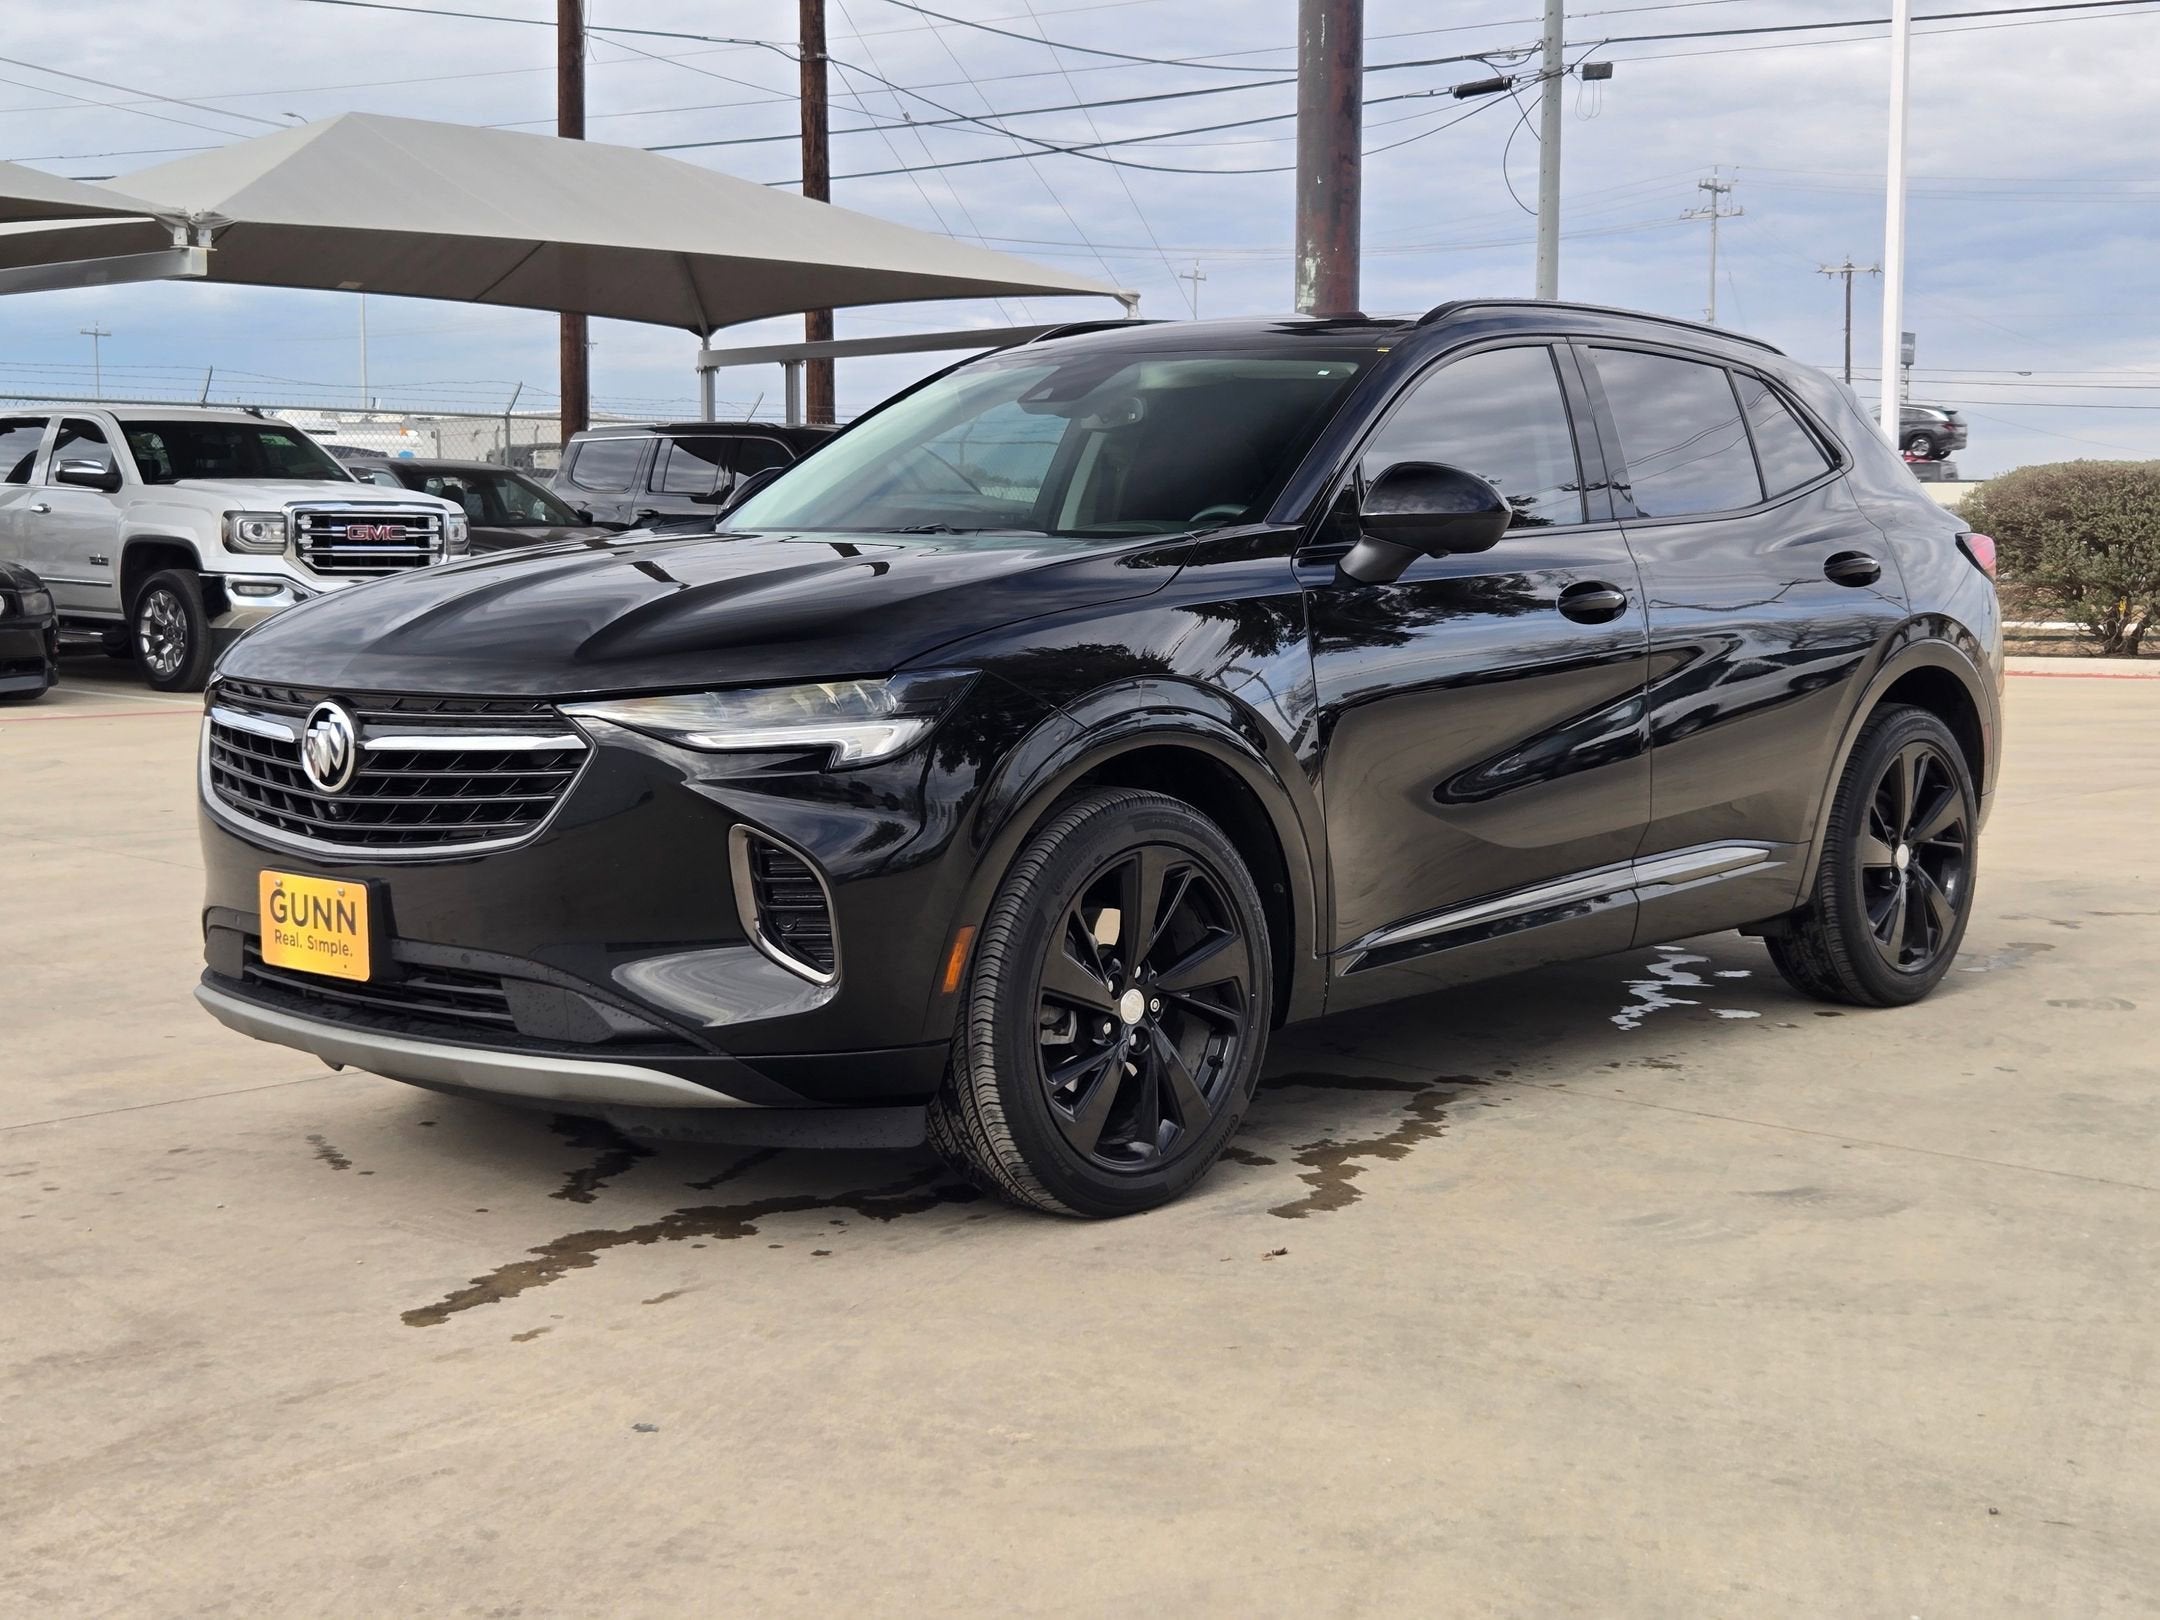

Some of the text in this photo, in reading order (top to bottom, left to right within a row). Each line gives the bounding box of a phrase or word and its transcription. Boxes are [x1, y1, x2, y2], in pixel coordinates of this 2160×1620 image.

[347, 524, 406, 540] GMC
[269, 888, 356, 936] GUNN
[274, 928, 353, 957] Real. Simple.
